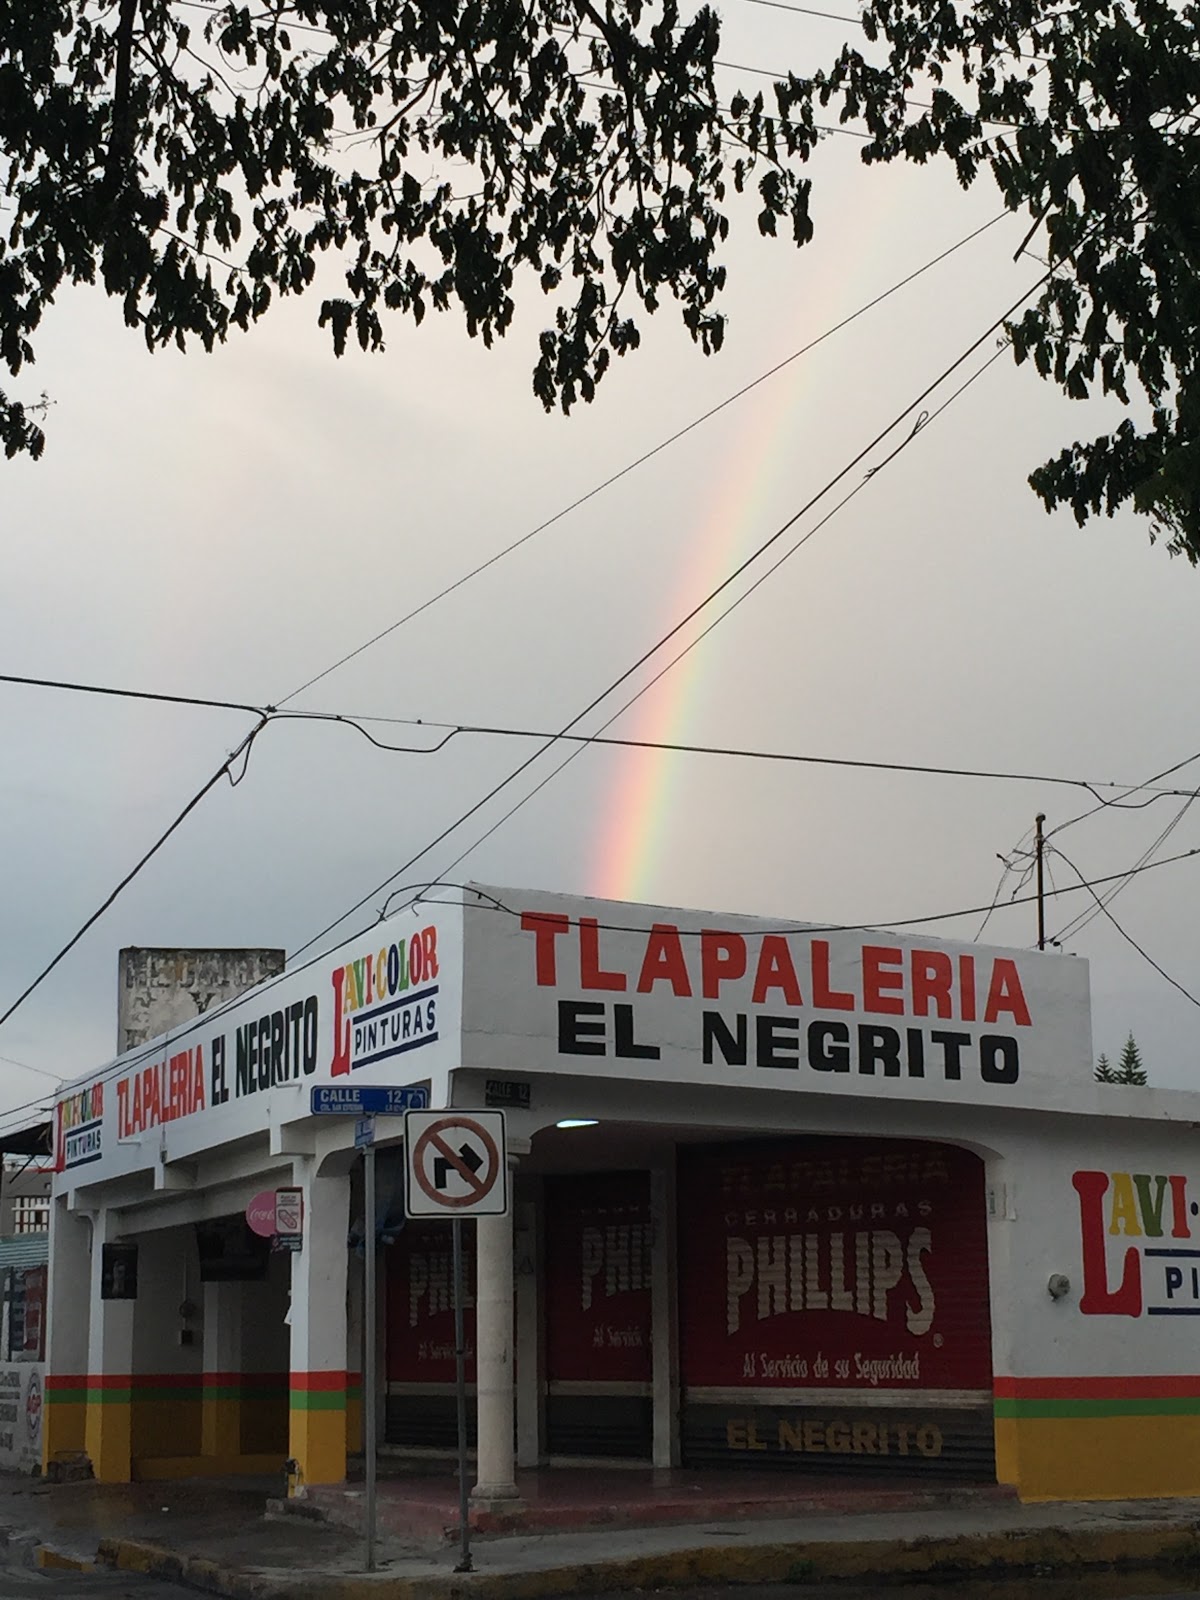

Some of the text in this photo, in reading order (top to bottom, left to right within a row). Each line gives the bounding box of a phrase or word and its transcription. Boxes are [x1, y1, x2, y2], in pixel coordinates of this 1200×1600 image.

[520, 911, 1032, 1026] TLAPALERIA
[354, 1000, 436, 1055] PINTURAS
[558, 1000, 1019, 1084] EL NEGRITO
[117, 995, 319, 1139] TLAPALERIA EL NEGRITO
[320, 1089, 402, 1103] CALLE 12
[67, 1130, 101, 1159] PINTURAS
[724, 1199, 934, 1226] CERRADURAS
[726, 1227, 935, 1336] PHILLIPS
[743, 1351, 920, 1385] Al Servicio de su Seguridad
[726, 1418, 944, 1457] EL NEGRITO
